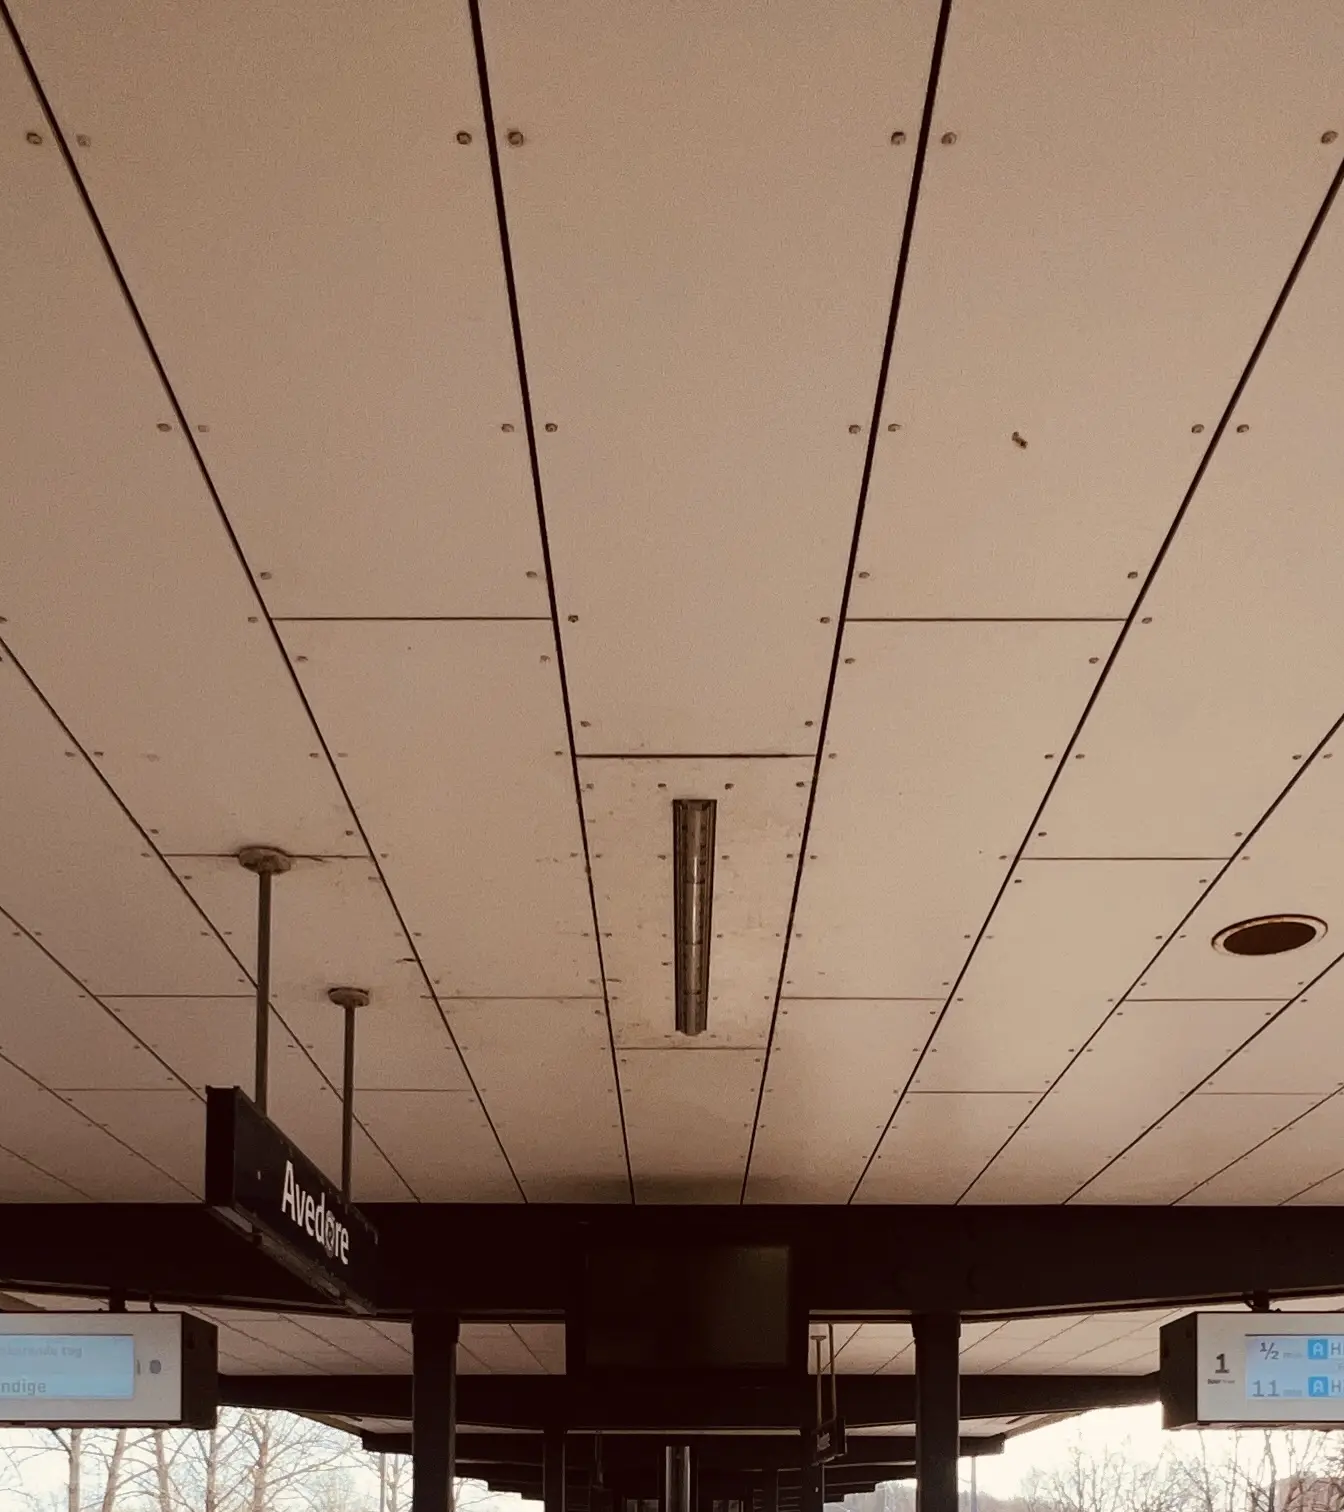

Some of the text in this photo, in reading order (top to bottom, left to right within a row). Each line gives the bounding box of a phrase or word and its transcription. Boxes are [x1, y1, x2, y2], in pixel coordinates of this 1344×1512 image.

[282, 1160, 349, 1265] Avedøre
[1215, 1353, 1230, 1373] 1
[1252, 1380, 1280, 1397] 11
